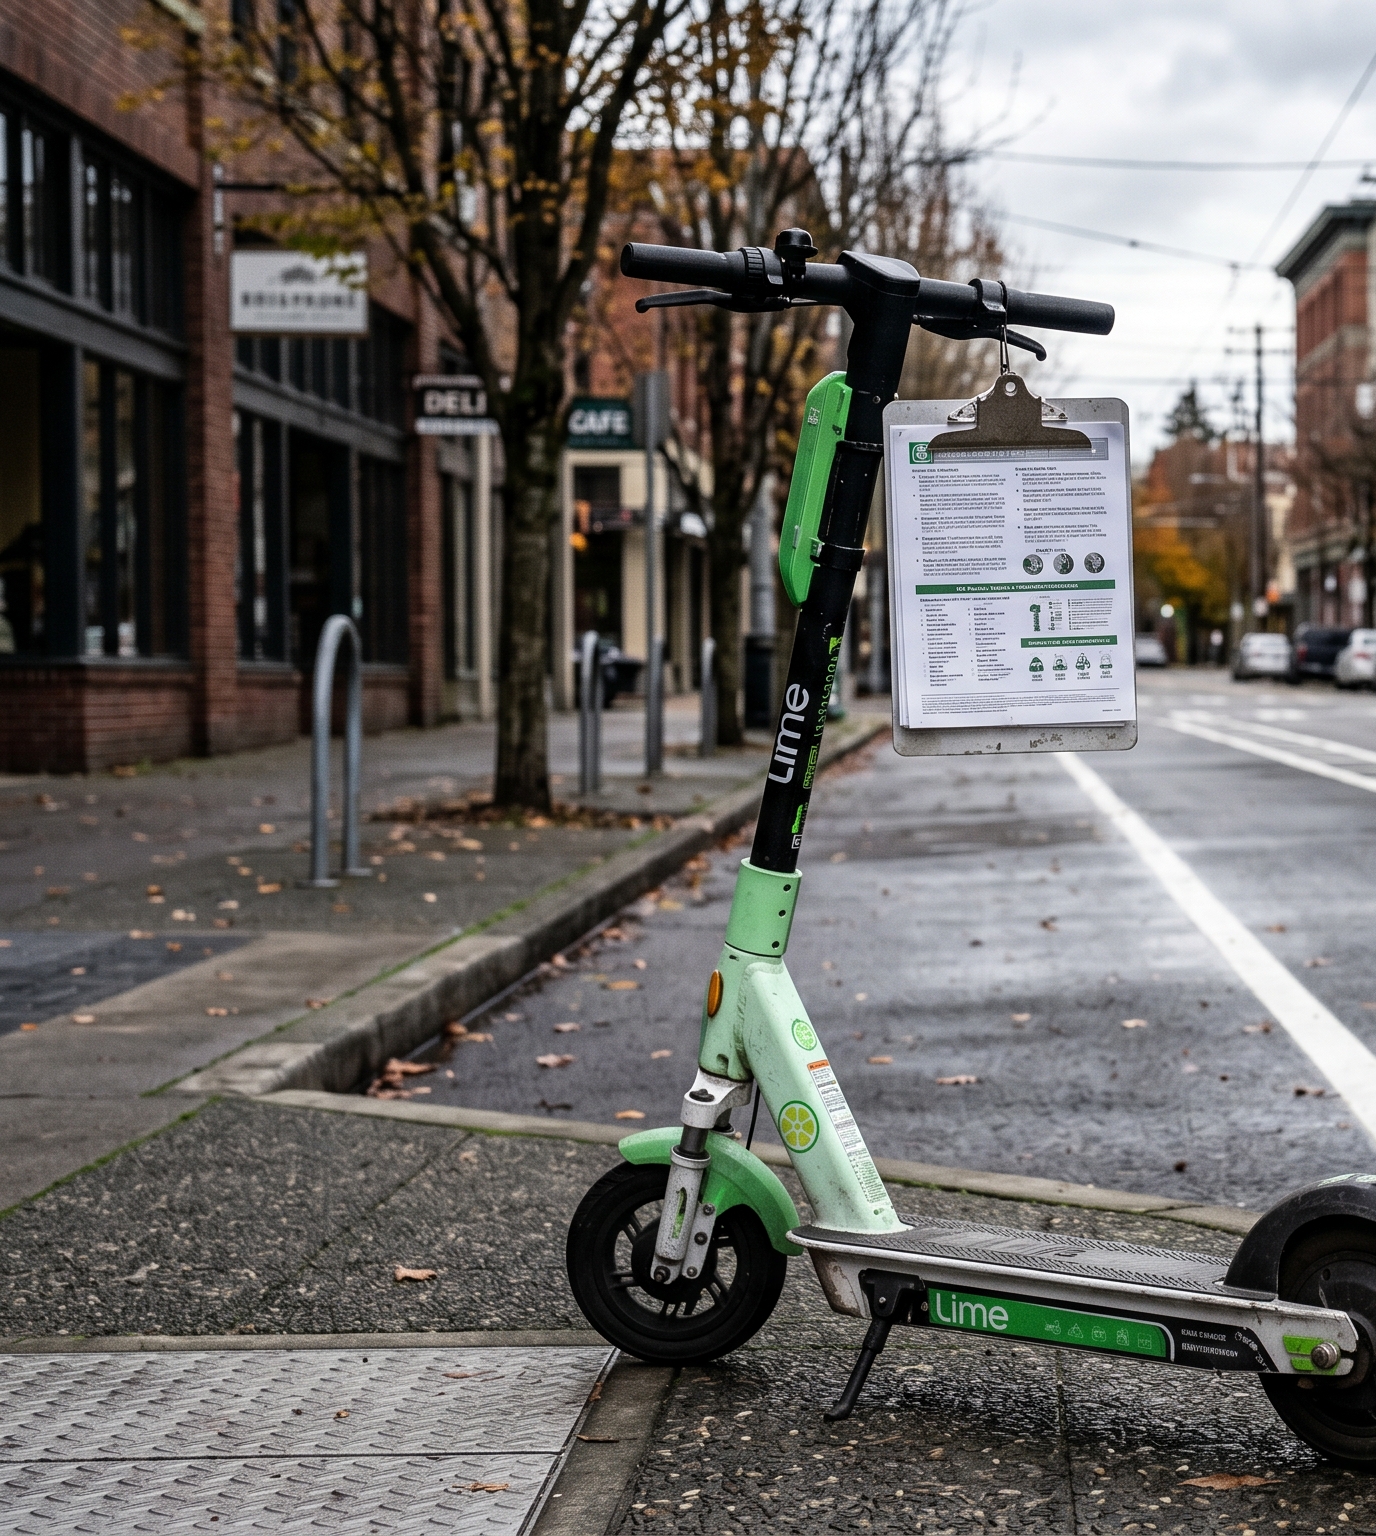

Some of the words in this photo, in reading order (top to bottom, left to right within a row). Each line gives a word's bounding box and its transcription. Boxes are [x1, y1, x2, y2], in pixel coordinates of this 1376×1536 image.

[424, 389, 487, 416] DELI
[568, 409, 629, 435] CAFE
[768, 683, 810, 784] Lime
[936, 1292, 1009, 1331] Lime
